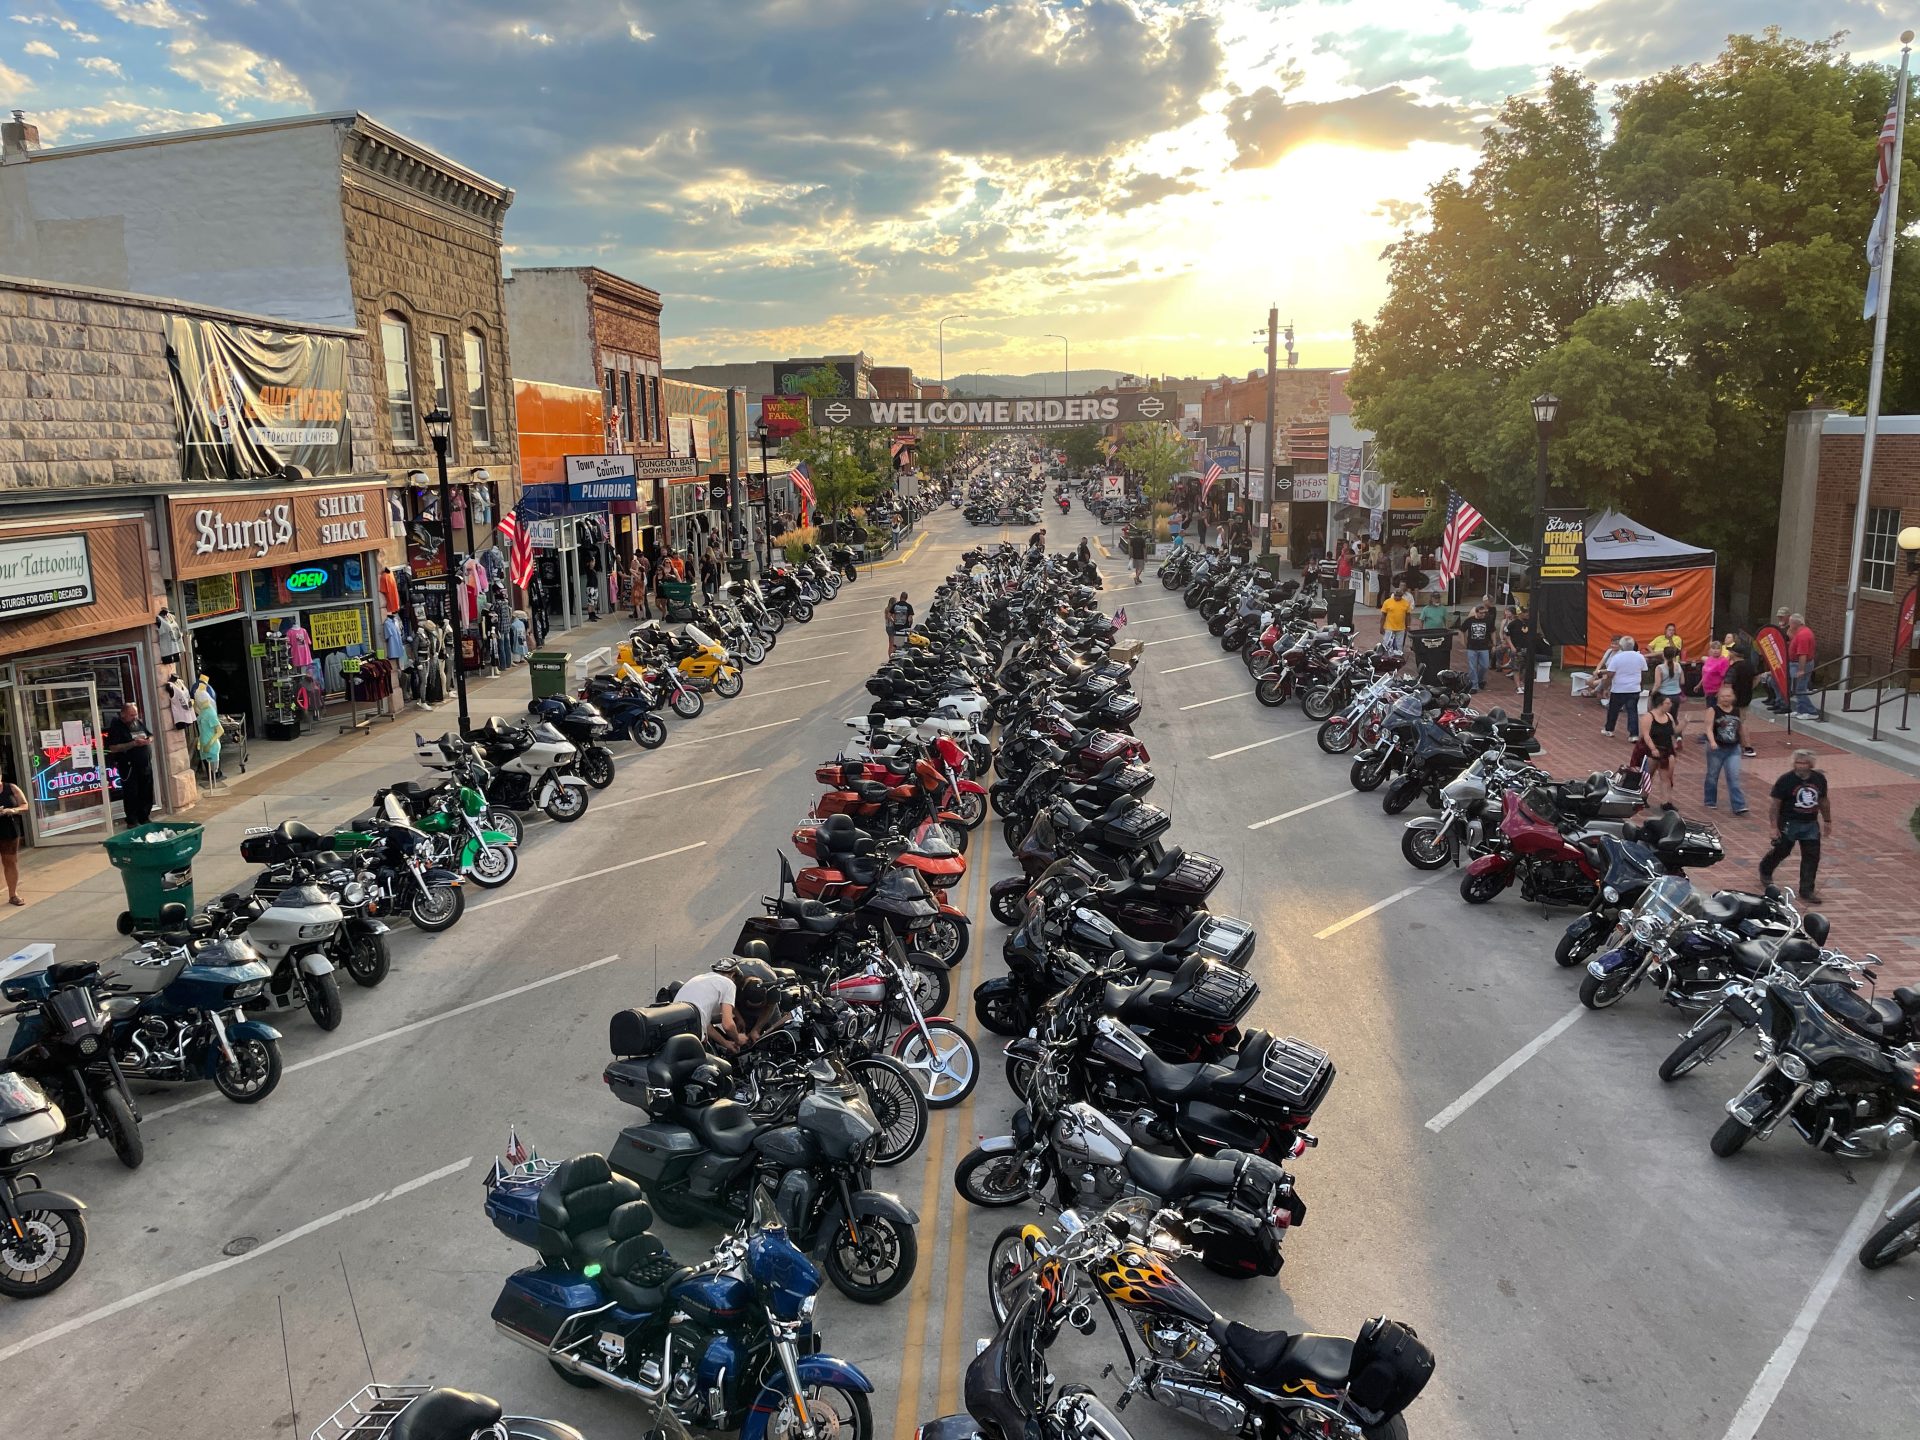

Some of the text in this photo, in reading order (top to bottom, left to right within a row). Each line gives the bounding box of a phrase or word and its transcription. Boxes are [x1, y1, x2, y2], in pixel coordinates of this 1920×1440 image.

[870, 398, 1120, 424] WELCOME RIDERS
[576, 459, 595, 471] Town
[639, 458, 695, 468] DUNGEON BAR
[643, 466, 693, 474] DOWNSTAIRS
[596, 464, 625, 477] Country
[1293, 478, 1328, 487] eakfast
[581, 483, 632, 498] PLUMBING
[1302, 489, 1321, 499] Day
[319, 494, 365, 517] SHIRT
[1425, 498, 1432, 507] 3
[321, 519, 368, 544] SHACK
[530, 522, 553, 539] ebCam
[1545, 518, 1583, 533] Sturgis
[1544, 532, 1583, 543] OFFICIAL
[1549, 544, 1576, 555] RALLY
[21, 549, 84, 577] Tattooing
[289, 573, 323, 588] OPEN
[2, 596, 26, 609] STURGIS
[26, 594, 39, 605] FOR
[38, 592, 54, 603] OVER
[58, 587, 83, 600] DECADES
[316, 631, 360, 648] THANK YOU!
[59, 785, 84, 796] GYPSY
